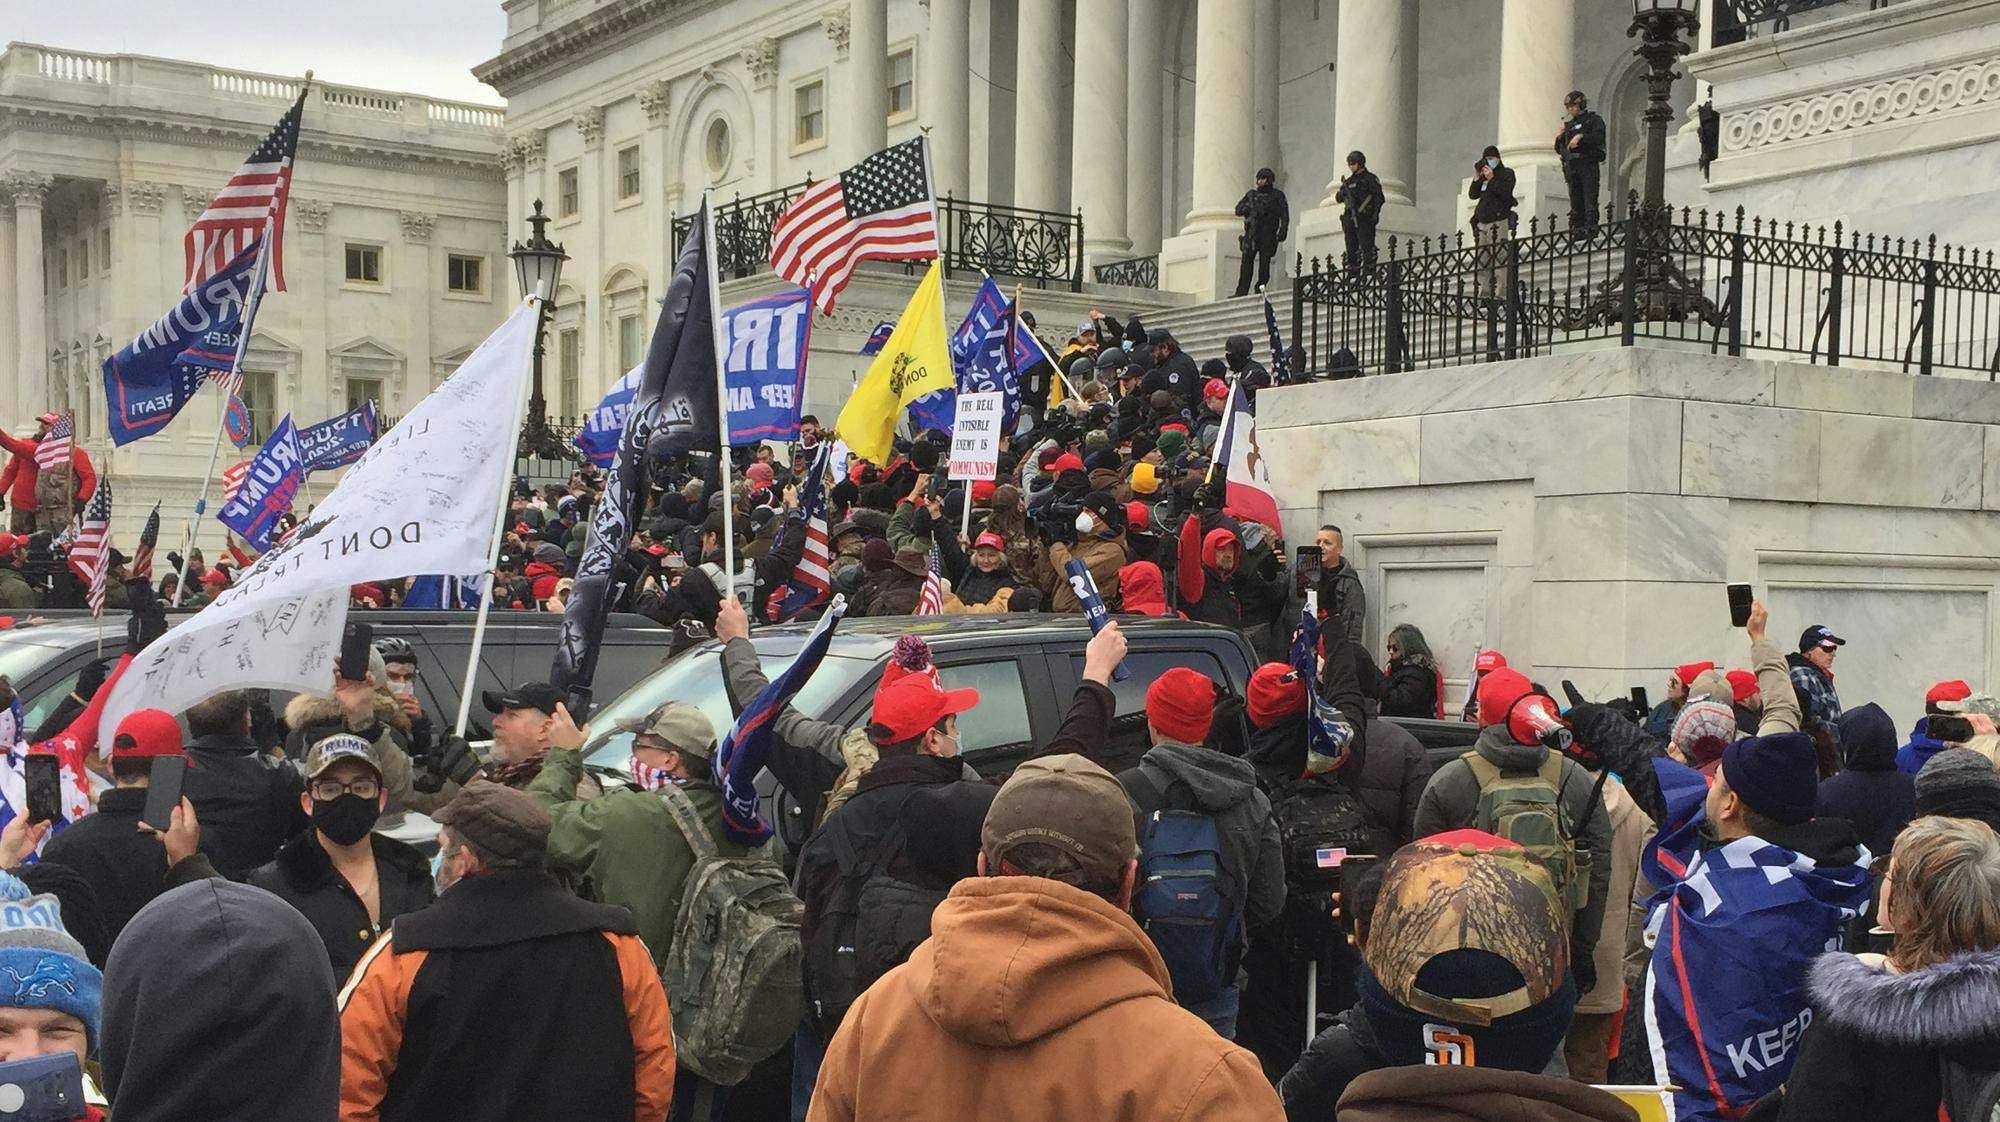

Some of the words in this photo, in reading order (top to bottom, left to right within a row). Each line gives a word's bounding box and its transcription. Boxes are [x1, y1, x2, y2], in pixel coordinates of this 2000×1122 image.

[961, 401, 973, 411] THE
[976, 400, 994, 411] REAL
[959, 420, 990, 431] INVISIBLE
[956, 440, 976, 450] ENEMY
[980, 440, 988, 450] IS
[949, 461, 996, 476] COMMUNISM
[317, 738, 369, 757] TRUMP
[1725, 1006, 1814, 1079] KEEP
